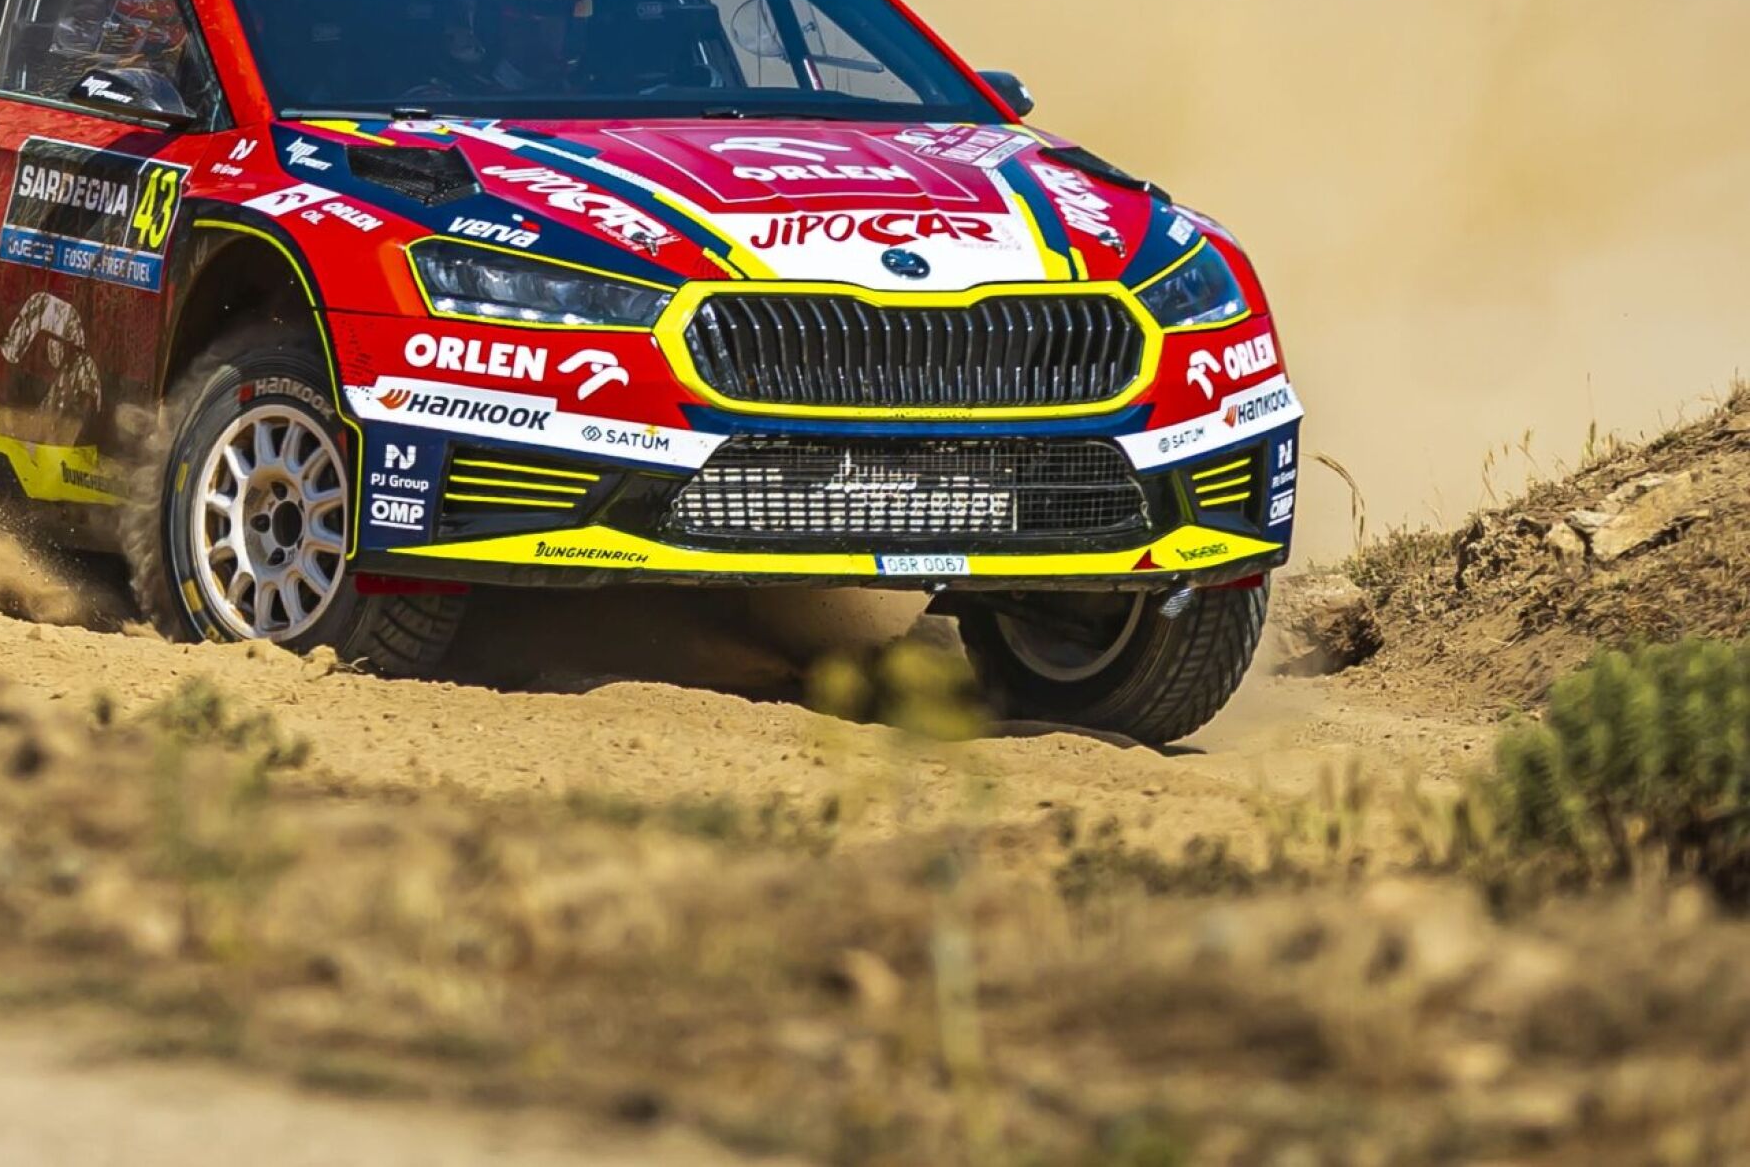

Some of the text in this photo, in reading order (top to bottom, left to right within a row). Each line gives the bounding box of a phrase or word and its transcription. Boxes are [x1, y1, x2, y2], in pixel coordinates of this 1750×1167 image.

[732, 164, 918, 184] ORLEN
[18, 164, 129, 217] SARDEGNA
[132, 167, 179, 249] 43
[321, 202, 383, 233] ORLEN
[750, 213, 1000, 247] JIPOCAR
[126, 261, 151, 282] FUEL
[404, 332, 548, 382] ORLEN
[605, 428, 671, 452] SATUM
[371, 473, 429, 493] PJ Group
[371, 500, 424, 524] OMP
[534, 541, 649, 563] JUNGHEINRICH
